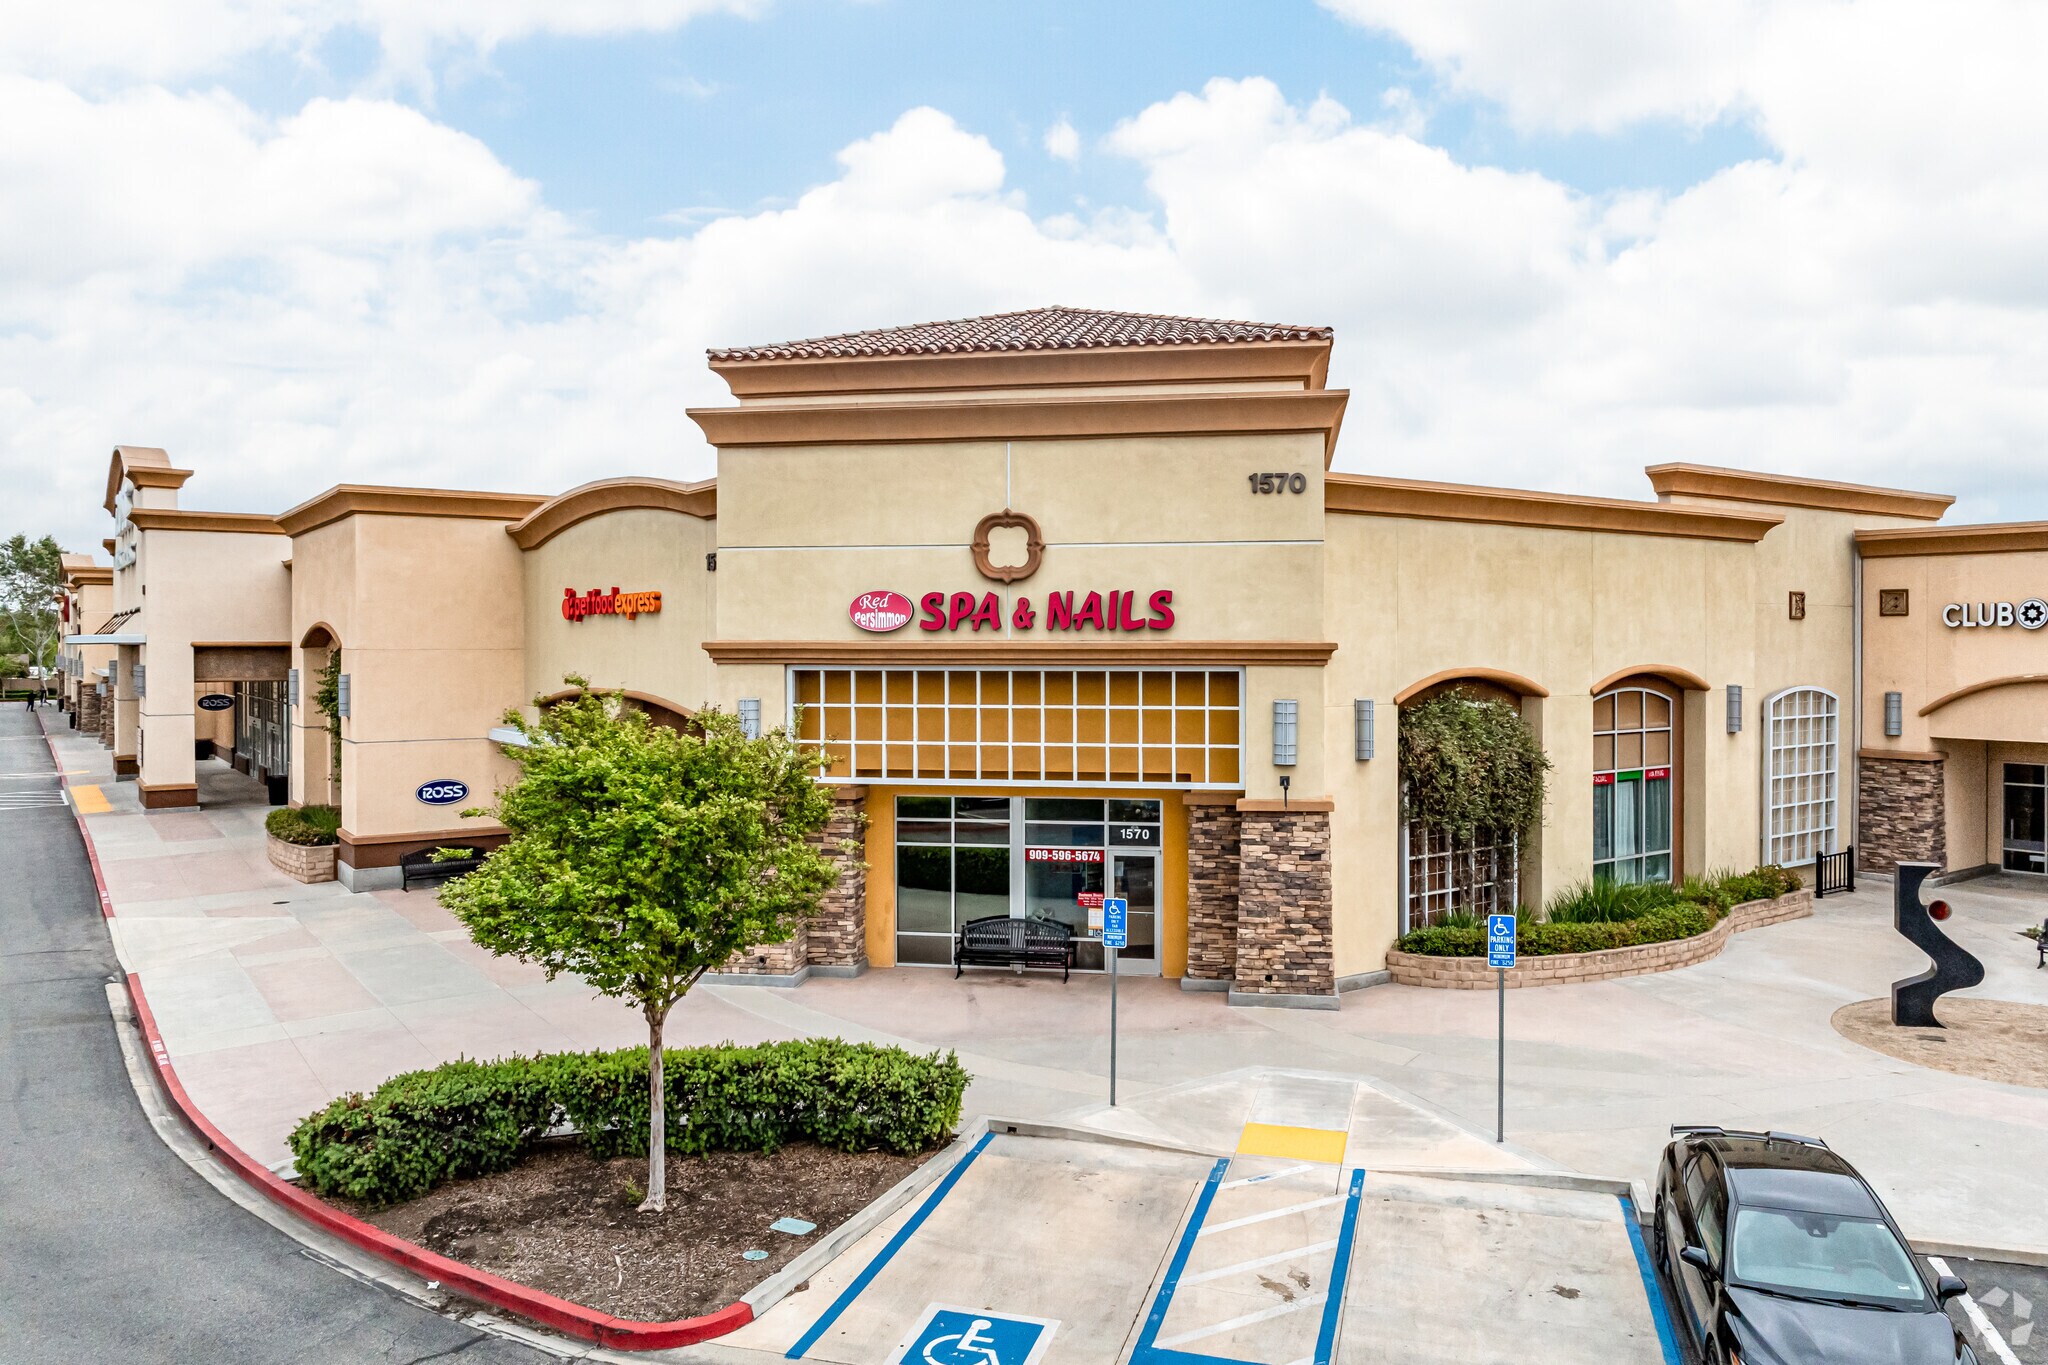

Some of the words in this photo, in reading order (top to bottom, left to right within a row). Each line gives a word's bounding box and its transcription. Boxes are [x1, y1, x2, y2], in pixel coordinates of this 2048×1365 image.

[1248, 472, 1307, 495] 1570
[614, 591, 662, 621] express
[859, 592, 893, 610] Red
[919, 591, 1001, 632] SPA
[1012, 597, 1036, 631] &
[1046, 589, 1176, 631] NAILS
[1942, 601, 2015, 629] CLUB
[202, 698, 231, 707] ROSS
[422, 785, 463, 799] ROSS
[1120, 829, 1150, 840] 1570
[1029, 849, 1101, 862] 909-596-5674
[1490, 935, 1514, 944] PARKING
[1494, 944, 1510, 952] ONLY
